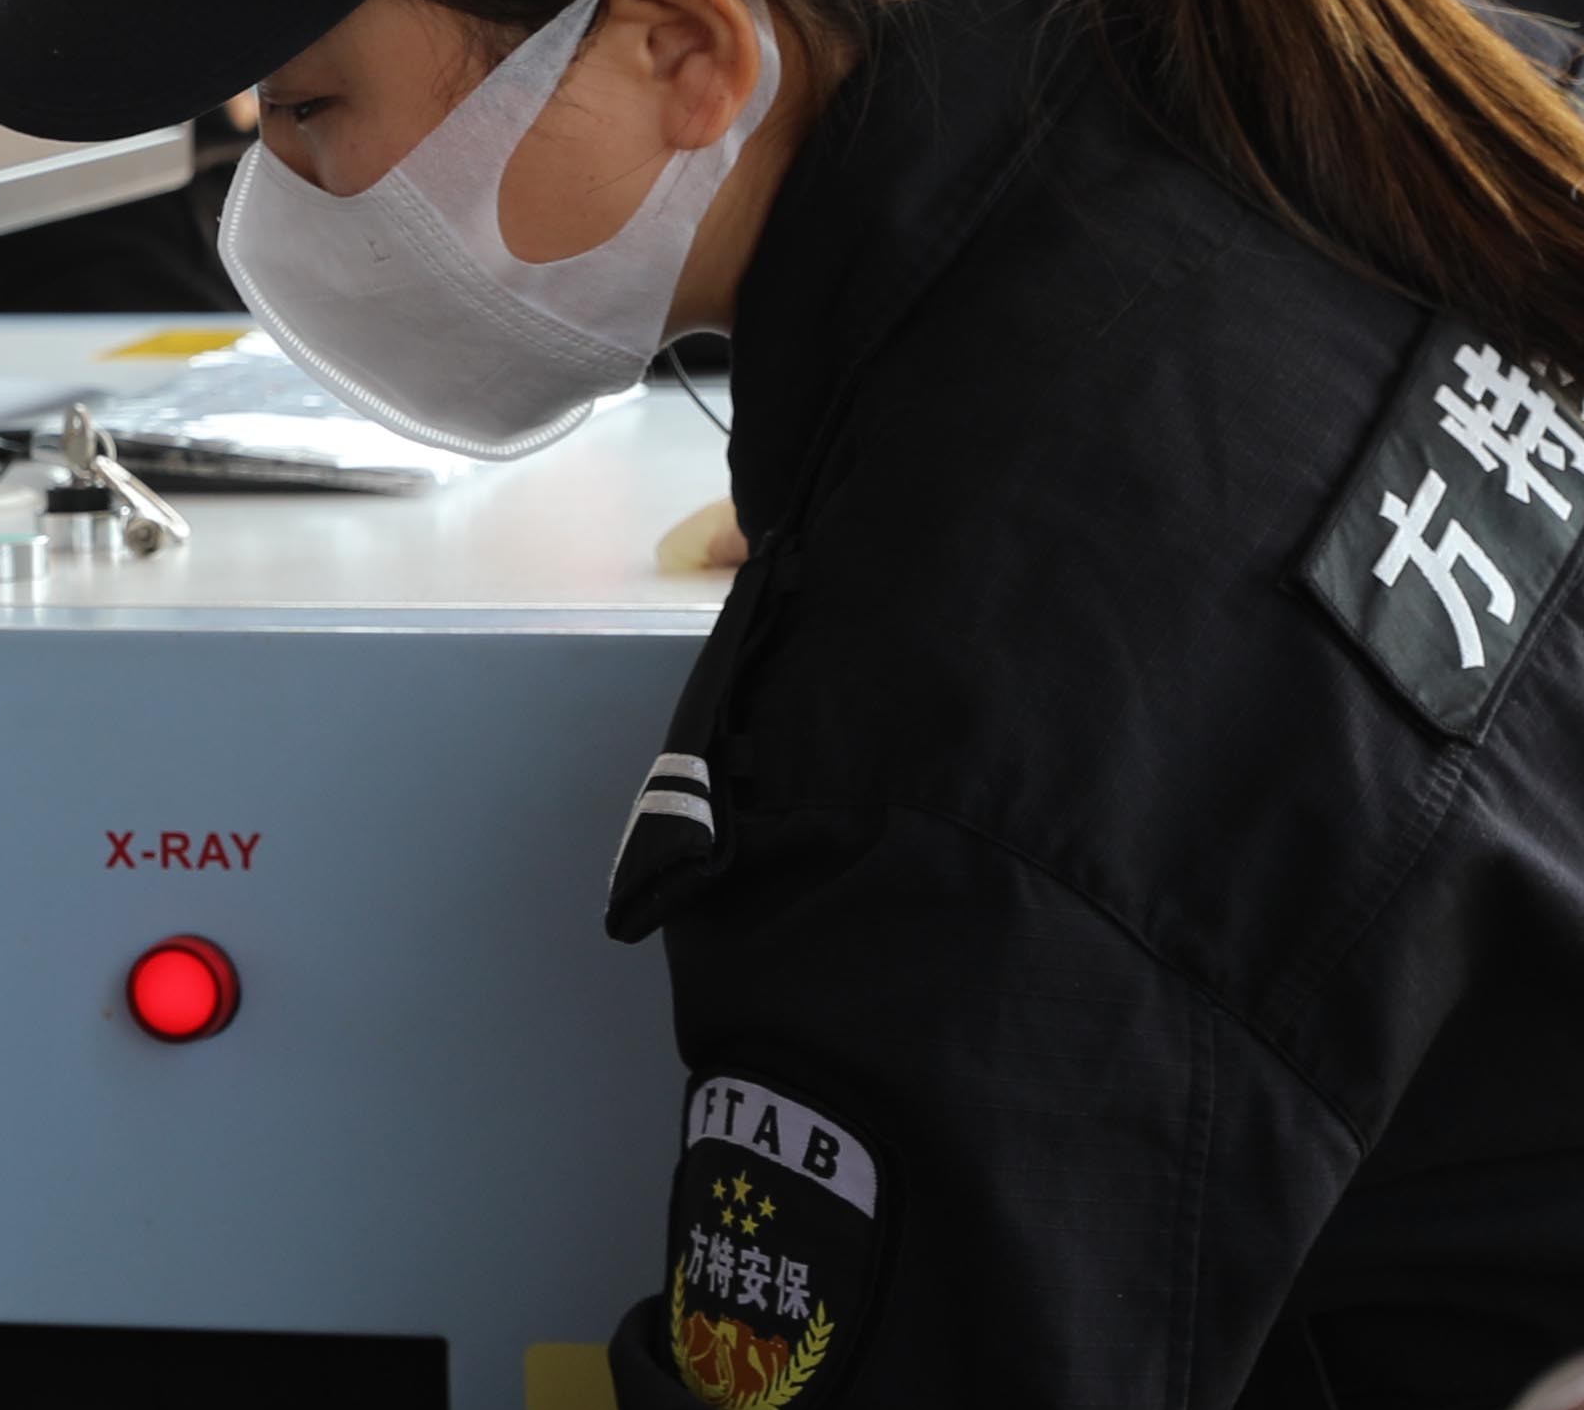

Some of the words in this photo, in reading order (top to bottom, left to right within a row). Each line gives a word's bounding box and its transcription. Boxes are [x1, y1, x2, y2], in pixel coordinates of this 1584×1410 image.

[105, 830, 263, 873] X-RAY
[701, 1087, 840, 1181] FTAB
[686, 1223, 810, 1320] 方特安保
